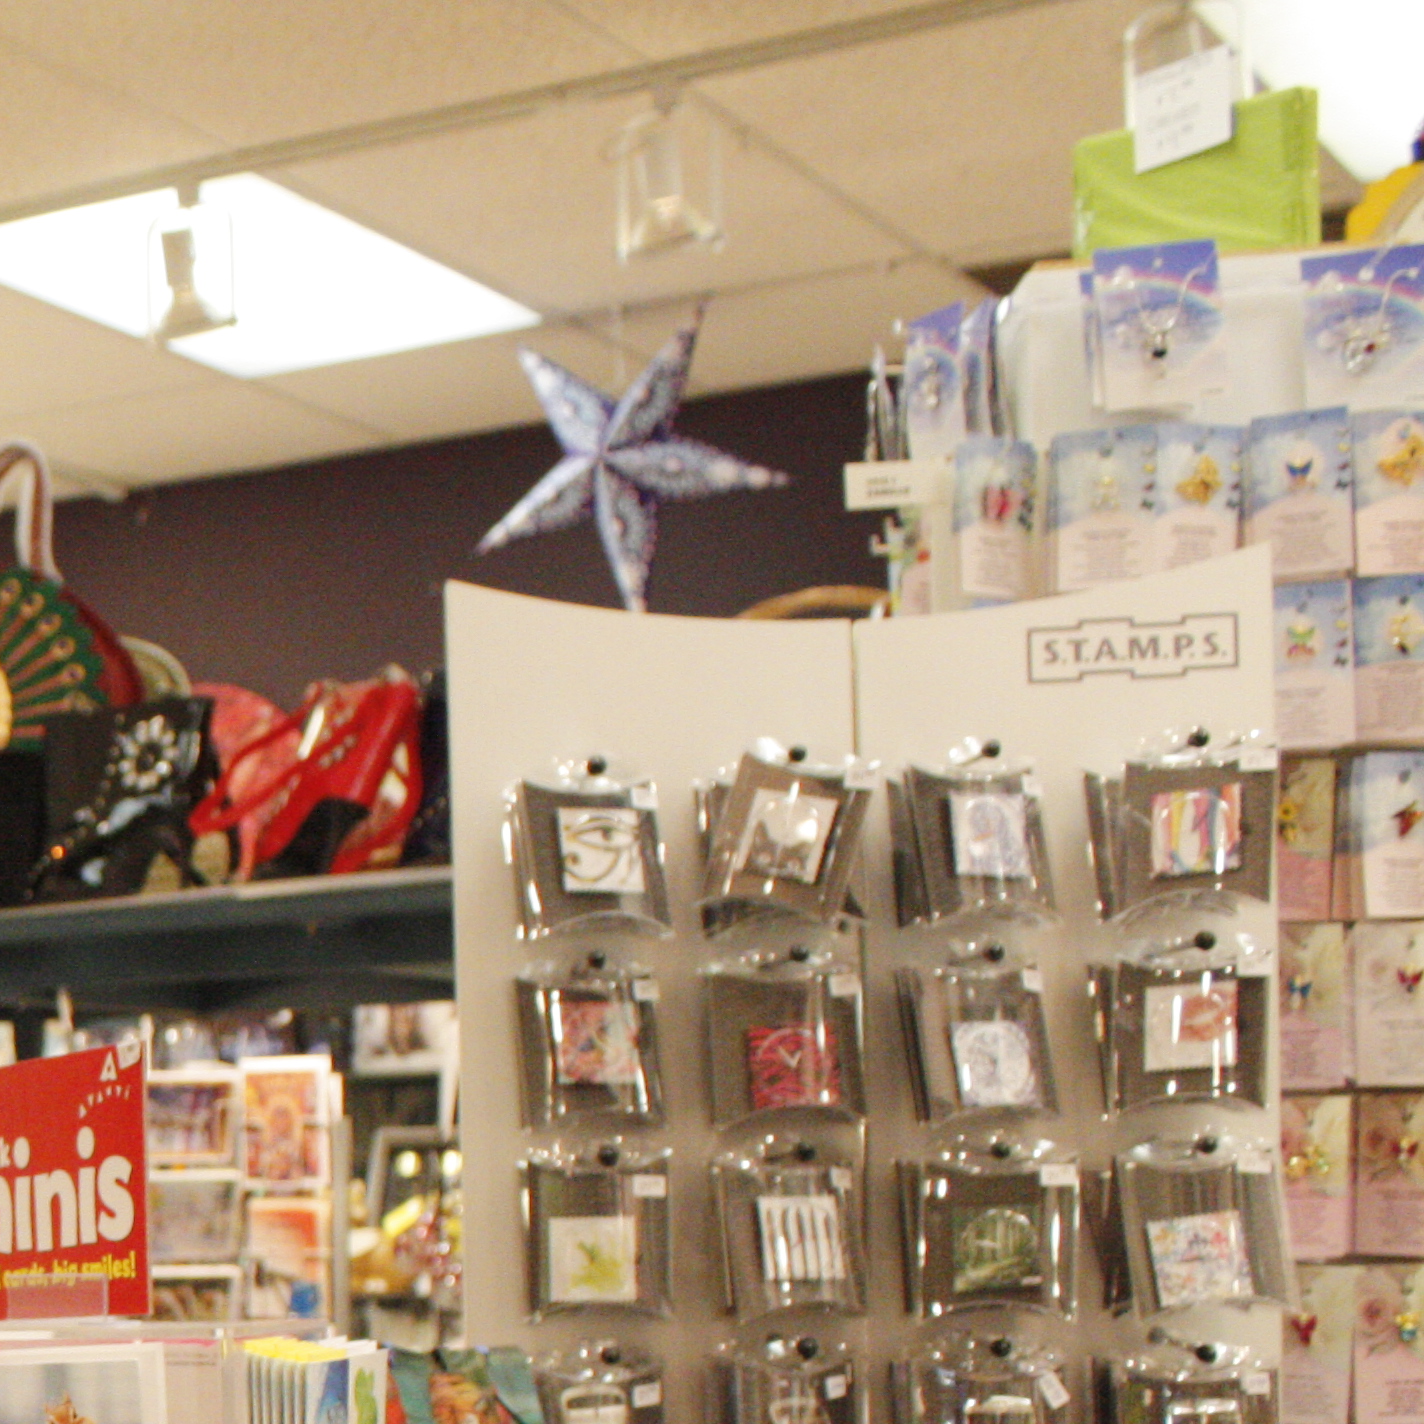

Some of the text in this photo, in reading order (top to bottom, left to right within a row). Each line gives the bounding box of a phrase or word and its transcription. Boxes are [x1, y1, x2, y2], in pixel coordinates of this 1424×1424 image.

[1044, 631, 1227, 665] S.T.A.M.P.S.
[53, 1260, 78, 1287] big
[82, 1251, 137, 1281] smiles!
